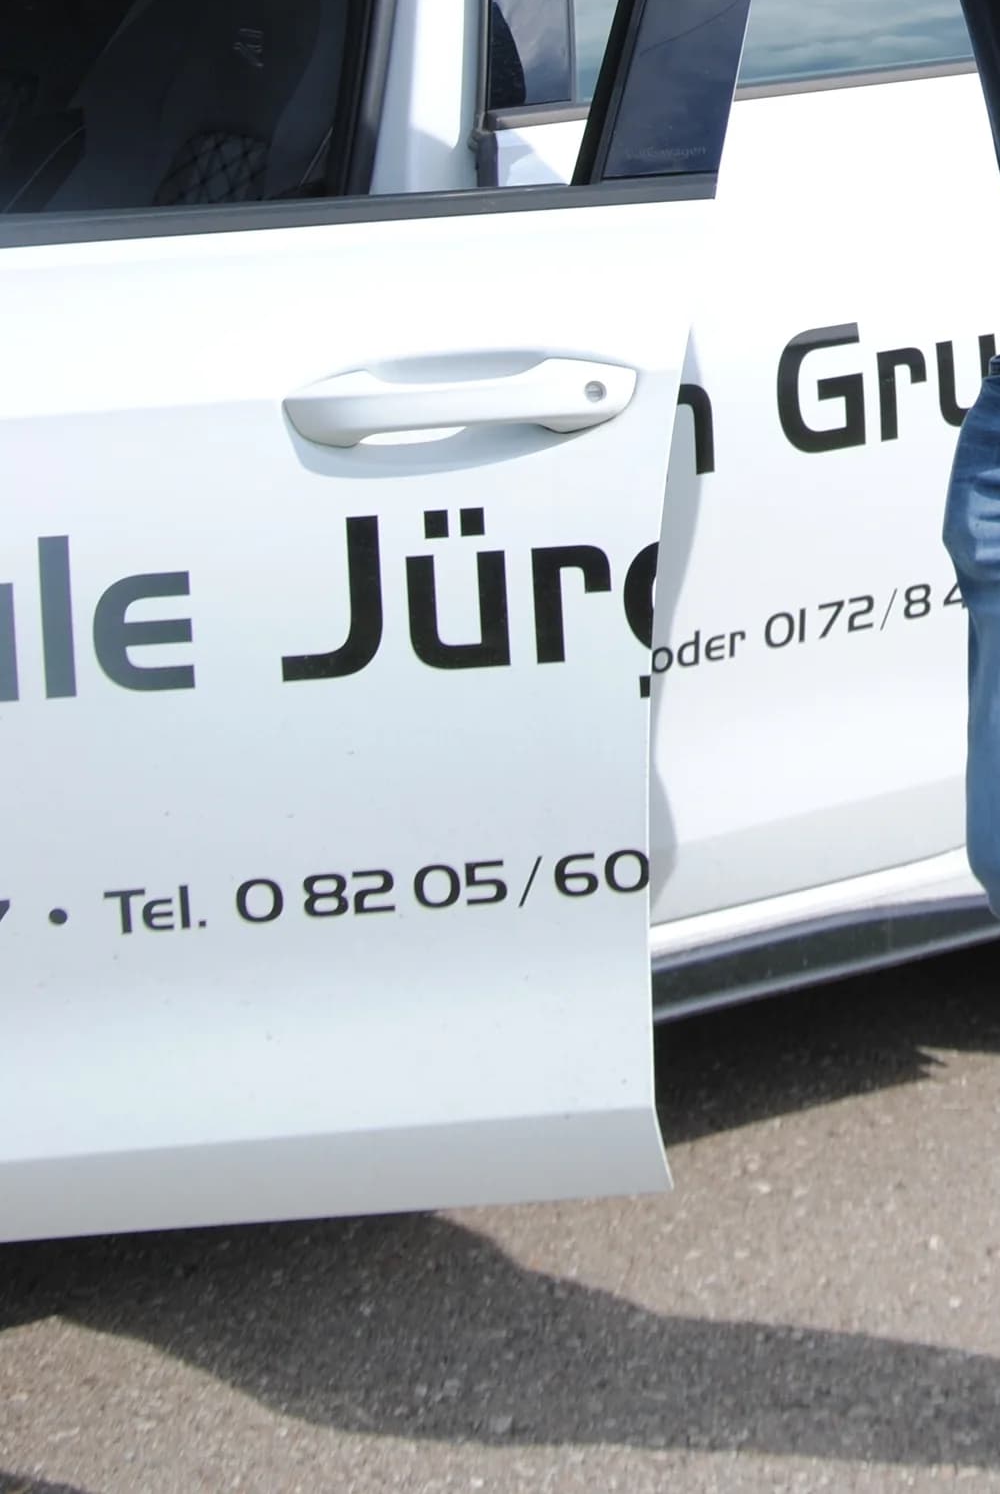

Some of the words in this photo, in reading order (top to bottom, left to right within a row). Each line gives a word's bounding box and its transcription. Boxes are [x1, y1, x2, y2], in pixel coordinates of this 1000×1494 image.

[0, 535, 196, 702] le
[652, 630, 746, 674] oder
[103, 884, 206, 935] Tel.
